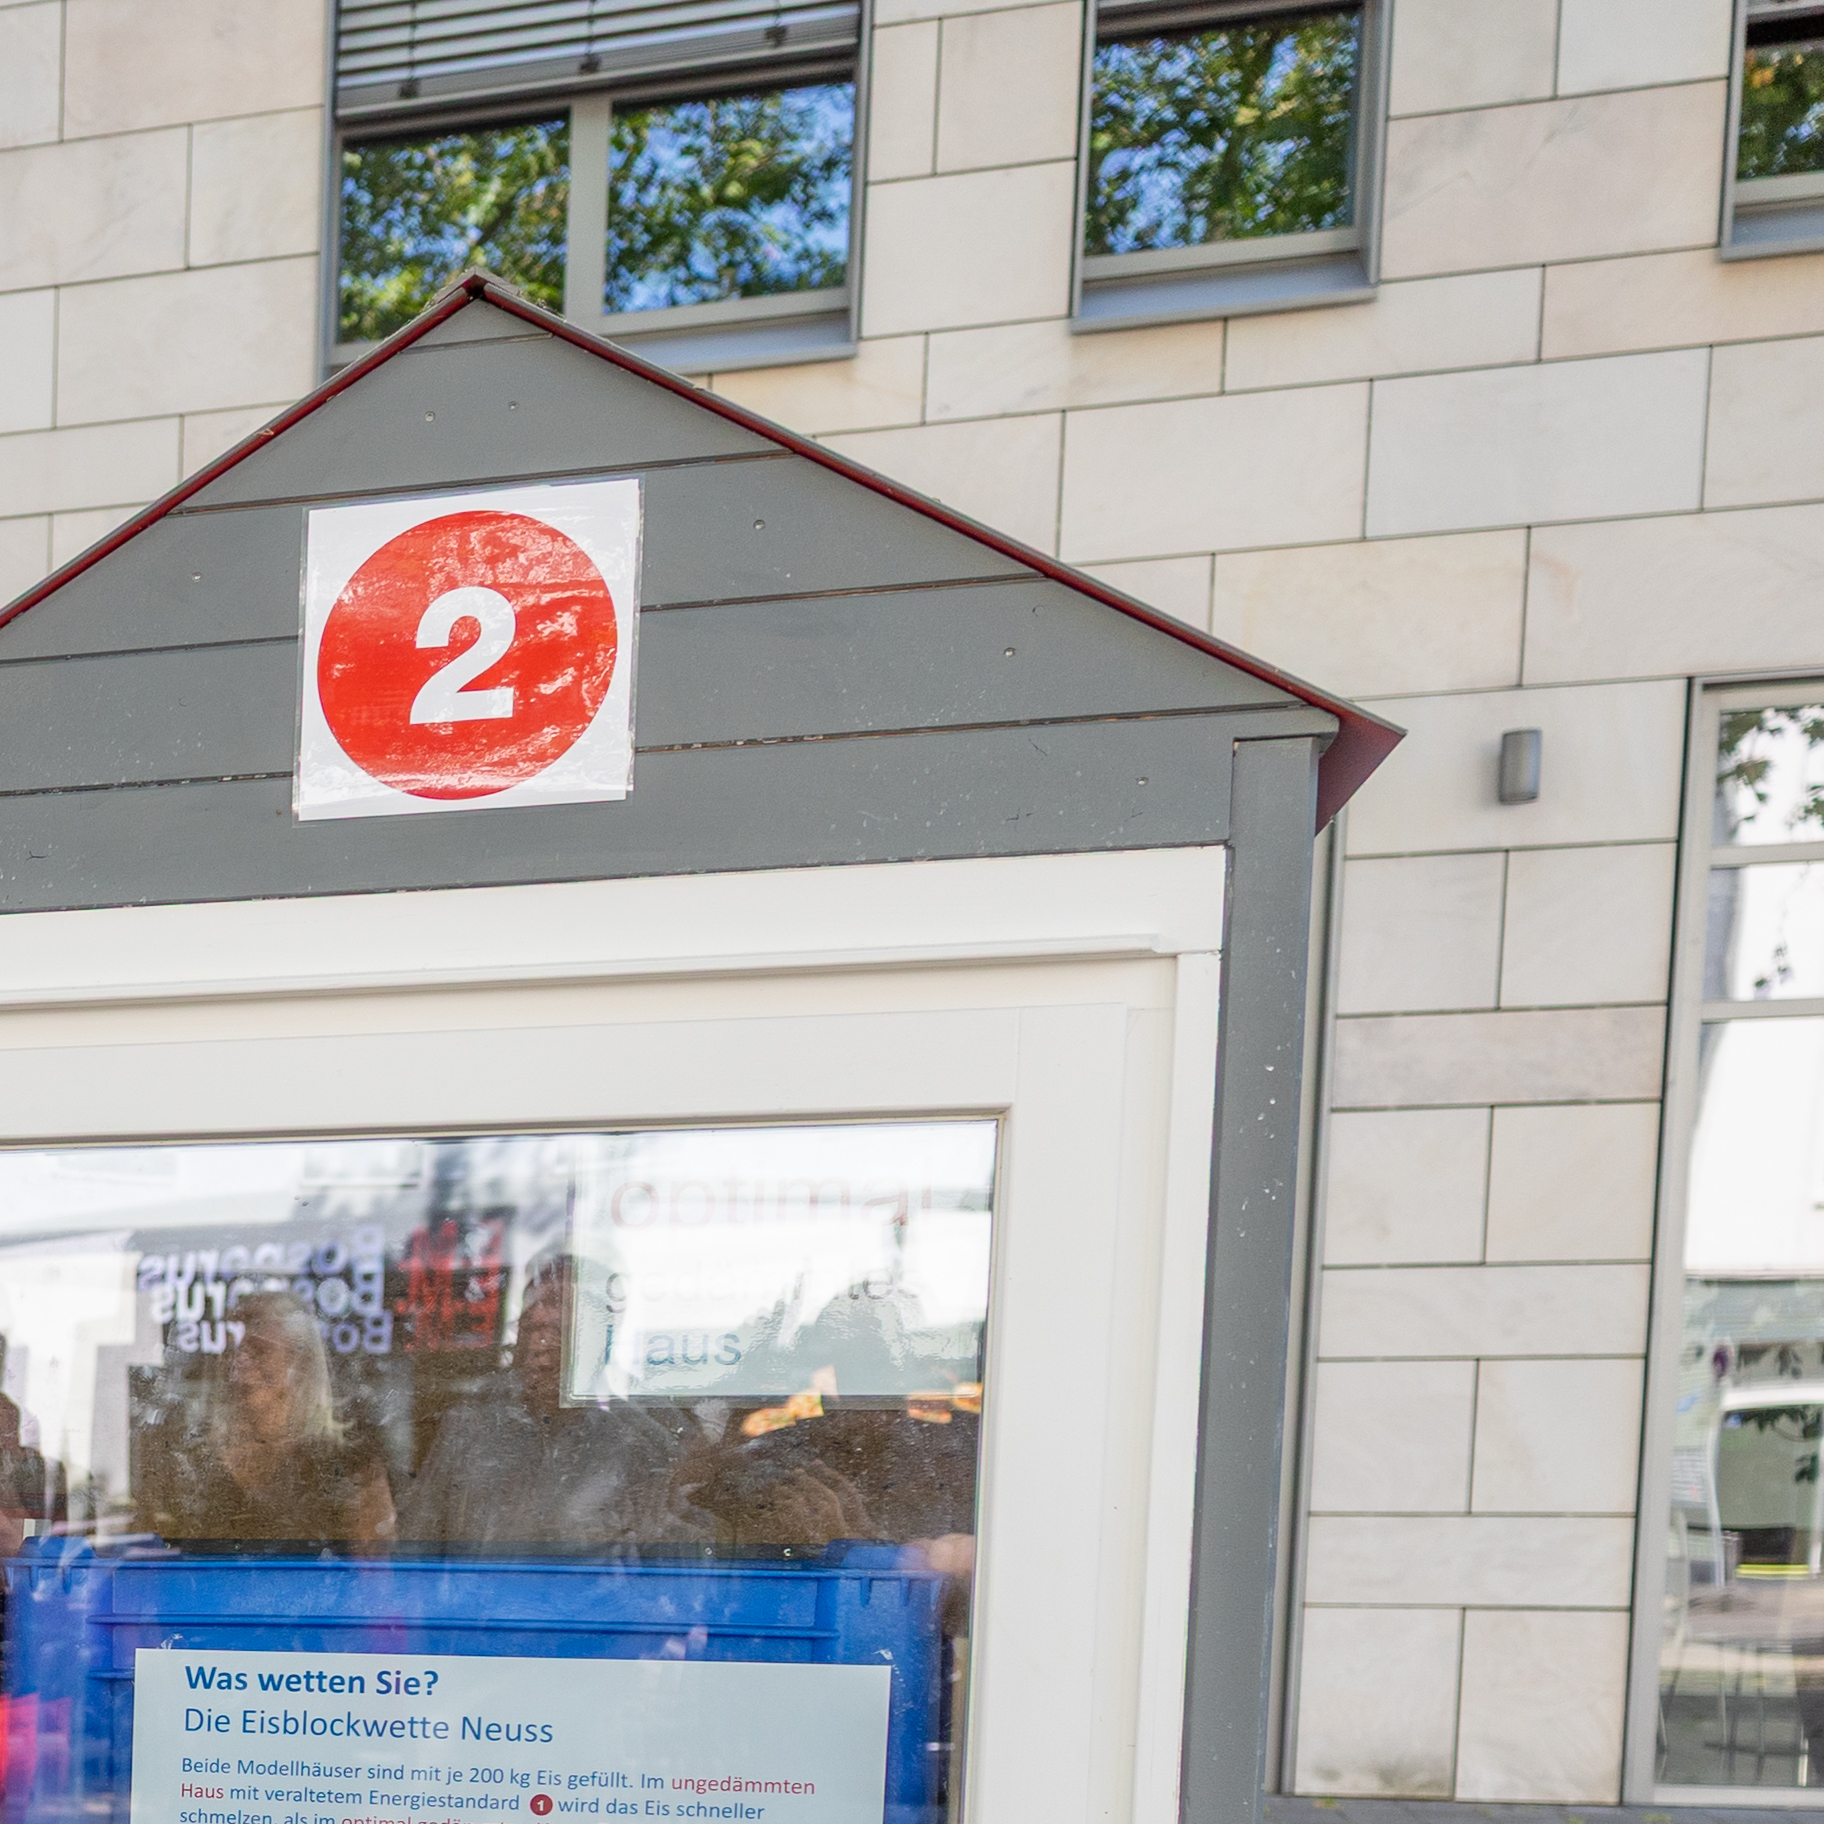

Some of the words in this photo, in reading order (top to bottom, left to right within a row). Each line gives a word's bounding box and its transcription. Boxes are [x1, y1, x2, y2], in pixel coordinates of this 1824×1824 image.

[409, 586, 518, 725] 2
[184, 1665, 248, 1691] Was
[257, 1670, 365, 1694] wetten
[375, 1670, 439, 1696] Sie?
[185, 1708, 231, 1733] Die
[242, 1709, 450, 1740] Eisblockwette
[461, 1716, 553, 1743] Neuss
[182, 1757, 231, 1774] Beide
[237, 1759, 363, 1779] Modellhäuser
[367, 1764, 405, 1780] sind
[411, 1766, 441, 1782] mit
[445, 1766, 463, 1786] je
[469, 1767, 504, 1784] 200
[510, 1768, 531, 1789] kg
[537, 1770, 562, 1786] Eis
[567, 1771, 633, 1790] gefüllt.
[641, 1773, 664, 1789] Im
[672, 1776, 815, 1795] ungedämmten
[181, 1783, 224, 1799] Haus
[230, 1785, 260, 1801] mit
[264, 1786, 362, 1804] veraltetem
[369, 1789, 520, 1811] Energiestandard
[557, 1797, 599, 1814] wird
[605, 1797, 638, 1815] das
[645, 1800, 670, 1816] Eis
[676, 1801, 765, 1820] schneller
